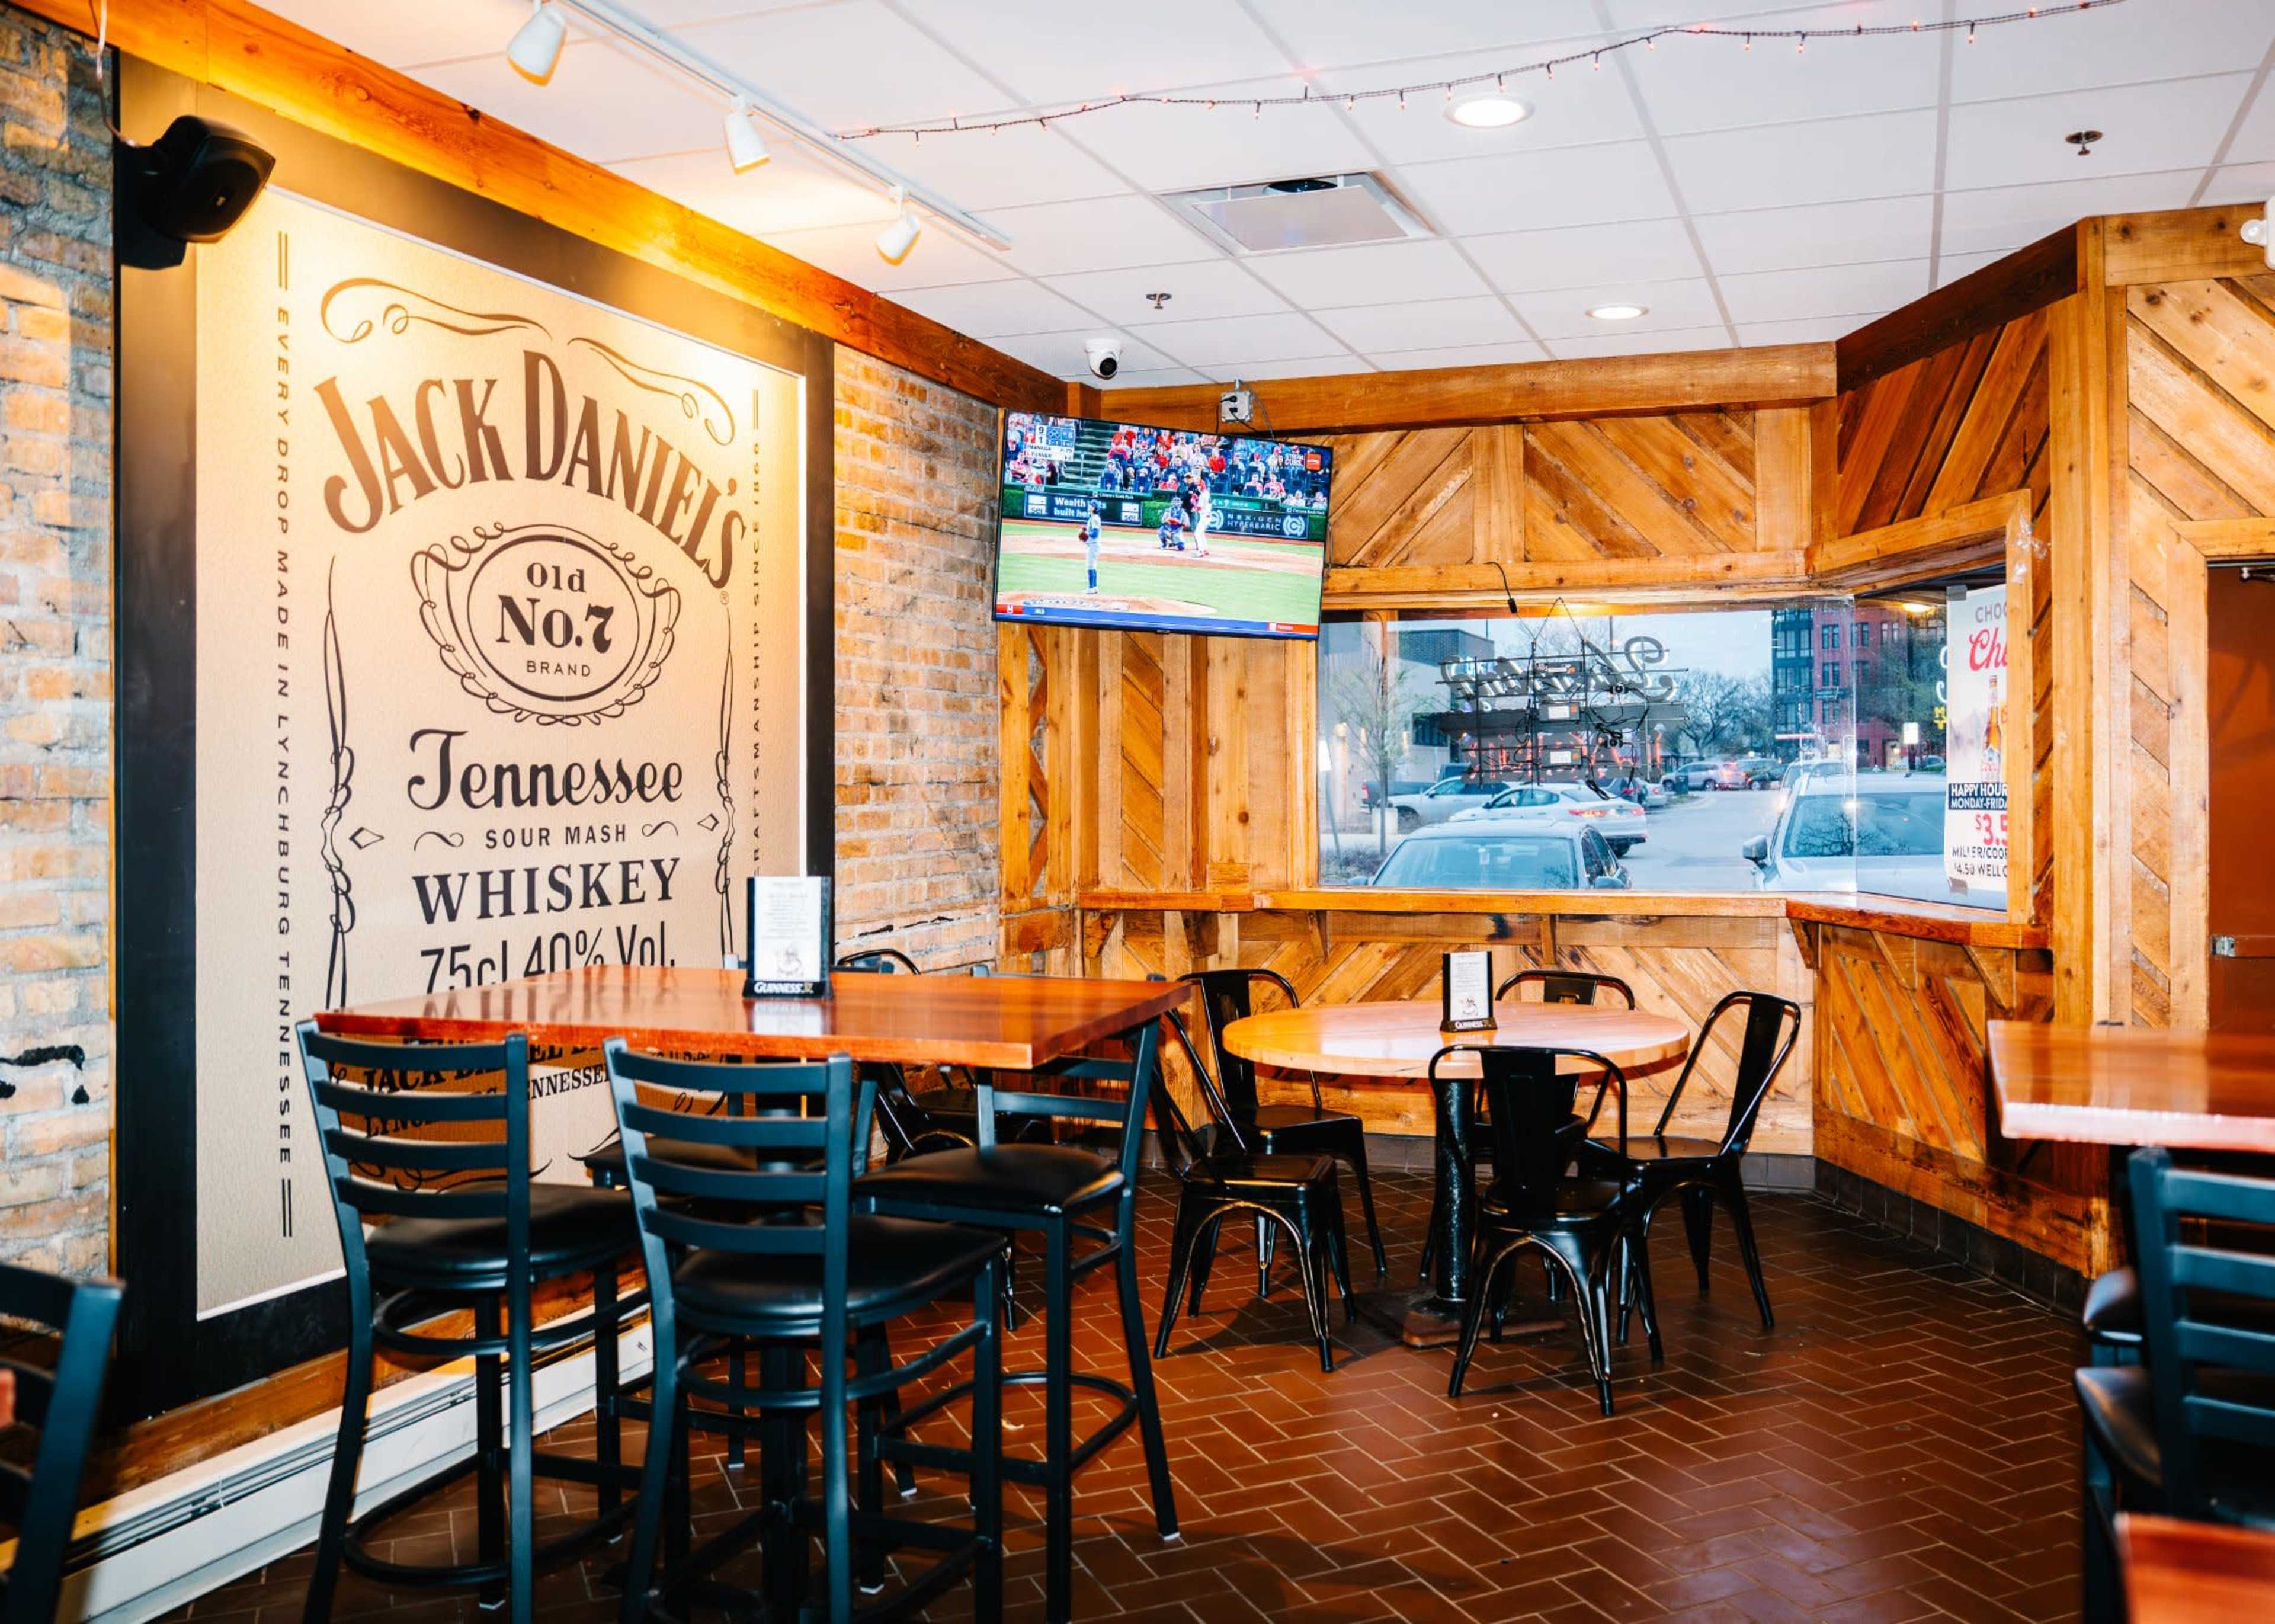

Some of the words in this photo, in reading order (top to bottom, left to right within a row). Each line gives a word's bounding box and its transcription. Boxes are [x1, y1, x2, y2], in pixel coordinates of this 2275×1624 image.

[277, 307, 289, 425] EVERY
[277, 438, 289, 534] DROP
[313, 376, 514, 534] JACK
[522, 348, 747, 590] DANIEL'S
[1054, 497, 1086, 507] Wealth
[1053, 507, 1074, 517] built
[1076, 510, 1091, 518] her
[277, 550, 289, 650] MADE
[526, 561, 587, 594] Old
[278, 664, 289, 697] IN
[526, 659, 592, 678] BRAND
[407, 728, 683, 811] Tennessee
[1951, 783, 1979, 797] HAPPY
[278, 715, 289, 936] LYNCHBURG
[485, 827, 551, 850] SOUR
[565, 824, 627, 845] MASH
[412, 857, 681, 925] WHISKEY
[1978, 864, 2001, 877] WELL
[420, 940, 508, 995] 75cl
[523, 927, 604, 978] 40%
[278, 951, 290, 1163] TENNESSEE
